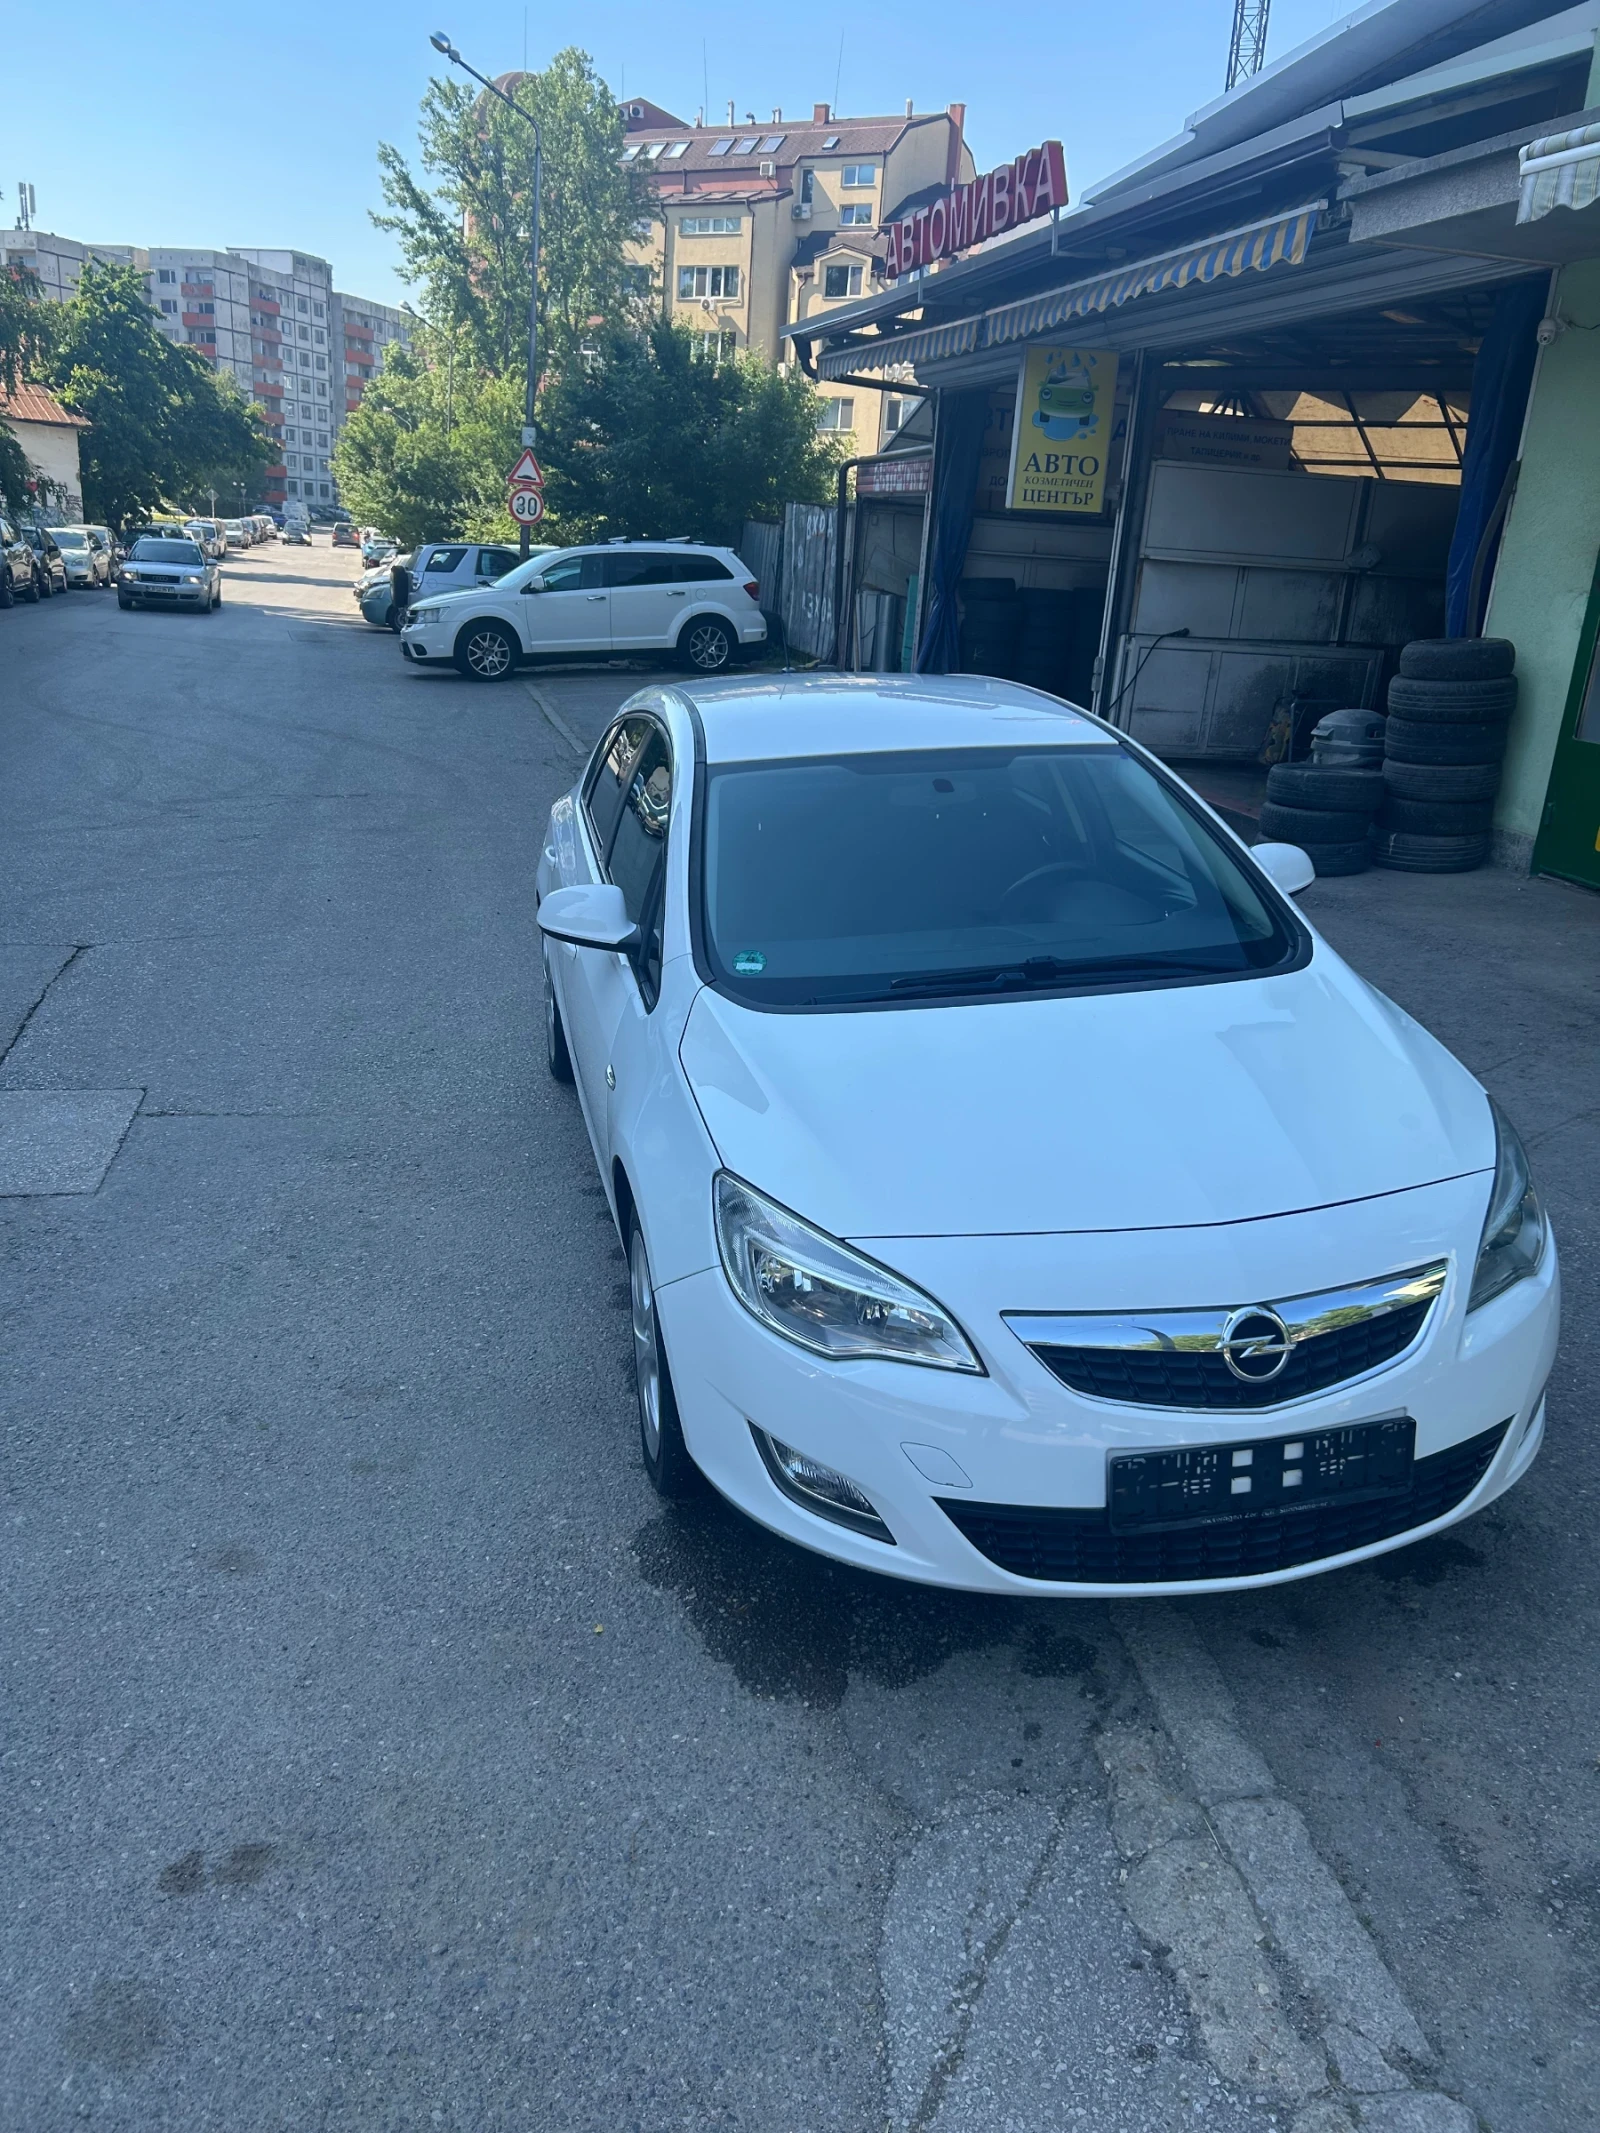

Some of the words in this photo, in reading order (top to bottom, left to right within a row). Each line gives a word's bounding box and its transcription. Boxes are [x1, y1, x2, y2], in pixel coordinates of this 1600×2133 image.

[885, 140, 1066, 279] АВТОМИВКА
[1166, 427, 1197, 438] ПРАНЕ
[1199, 430, 1211, 439] НА
[1023, 452, 1100, 477] АВТО
[1024, 475, 1094, 488] КОЗМЕТИЧЕН
[516, 496, 538, 516] 30
[1022, 488, 1094, 506] ЦЕНТЪР
